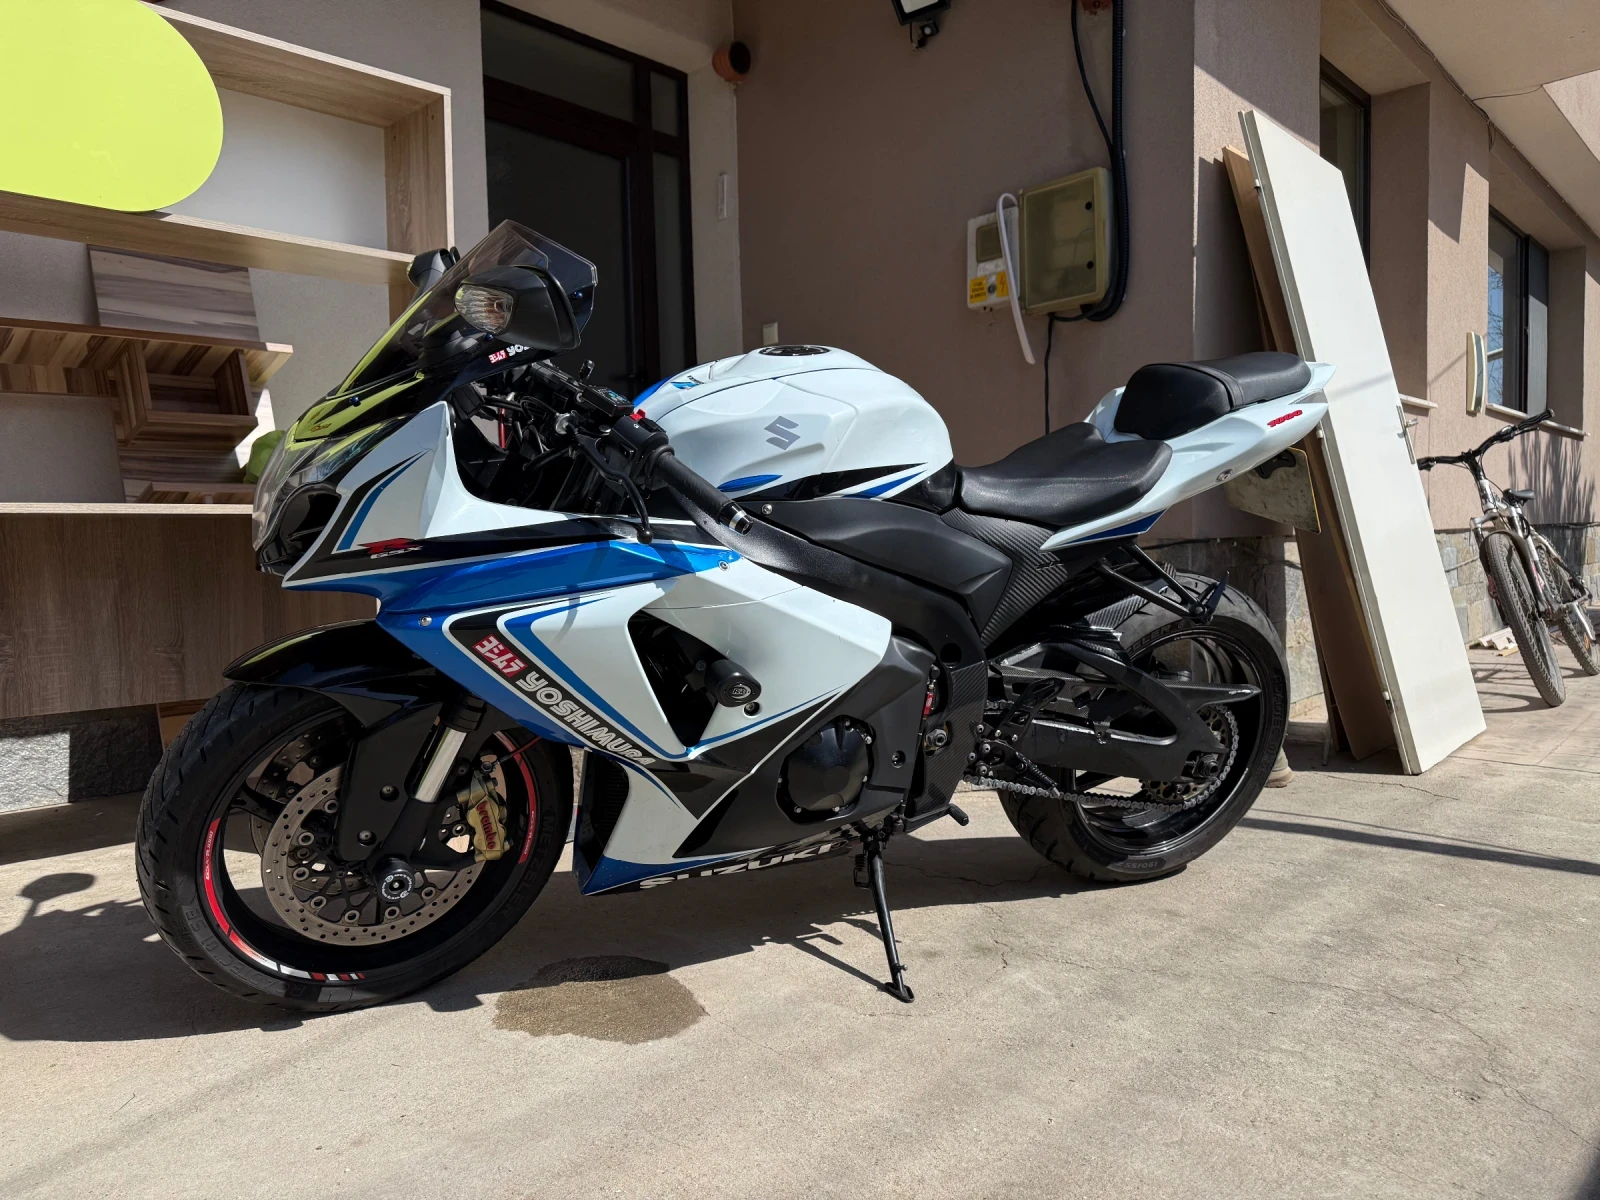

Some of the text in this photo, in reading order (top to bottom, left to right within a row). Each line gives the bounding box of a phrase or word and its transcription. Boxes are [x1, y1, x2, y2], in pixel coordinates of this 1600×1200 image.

[475, 635, 525, 674] ヨシムラ
[515, 670, 656, 766] YOSHIMURA
[476, 800, 498, 850] brembo
[640, 843, 832, 889] SUZUKI
